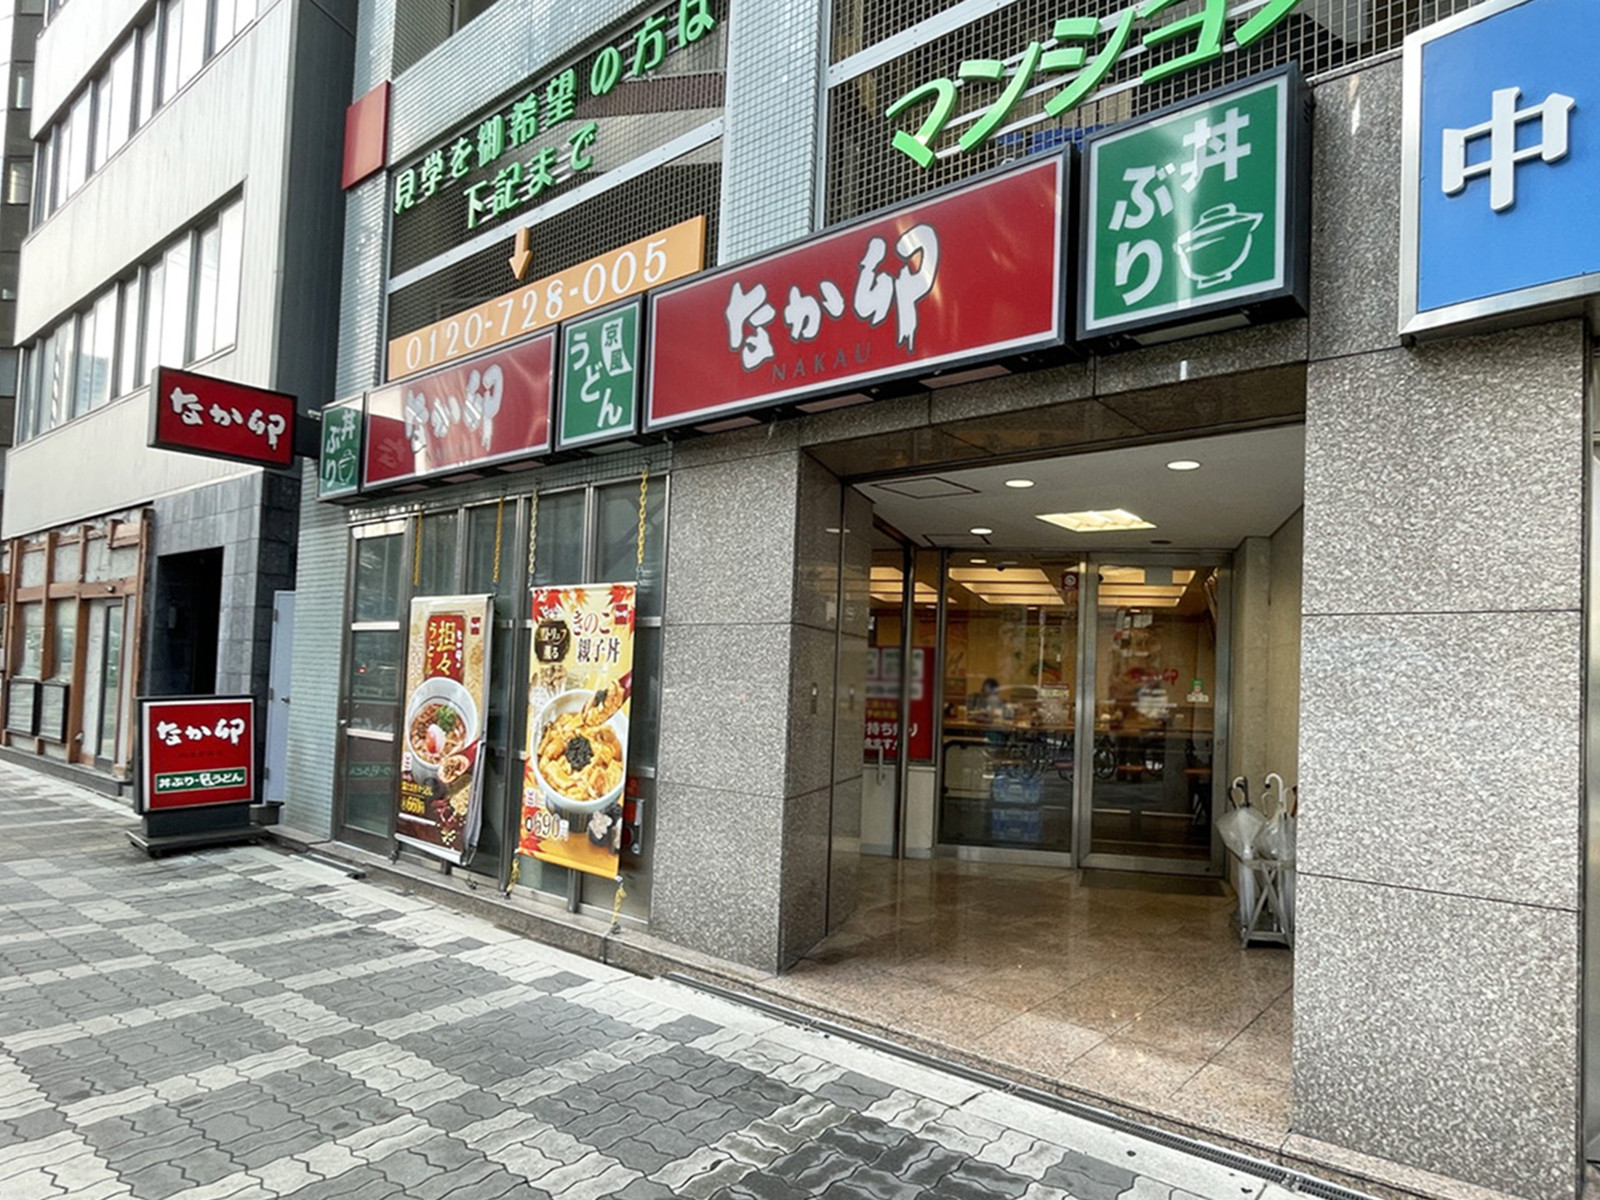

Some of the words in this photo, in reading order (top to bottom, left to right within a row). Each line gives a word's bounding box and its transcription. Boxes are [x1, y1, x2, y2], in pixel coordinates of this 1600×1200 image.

[394, 0, 716, 215] 見学を御希望の方は
[1442, 86, 1575, 212] 中
[463, 121, 599, 229] 下記まで
[405, 238, 668, 370] 0120-728-005
[726, 222, 939, 372] なか卯
[403, 363, 504, 454] なか卯
[772, 341, 873, 383] NAKAU
[170, 386, 286, 450] なか卯
[156, 717, 246, 746] なか卯
